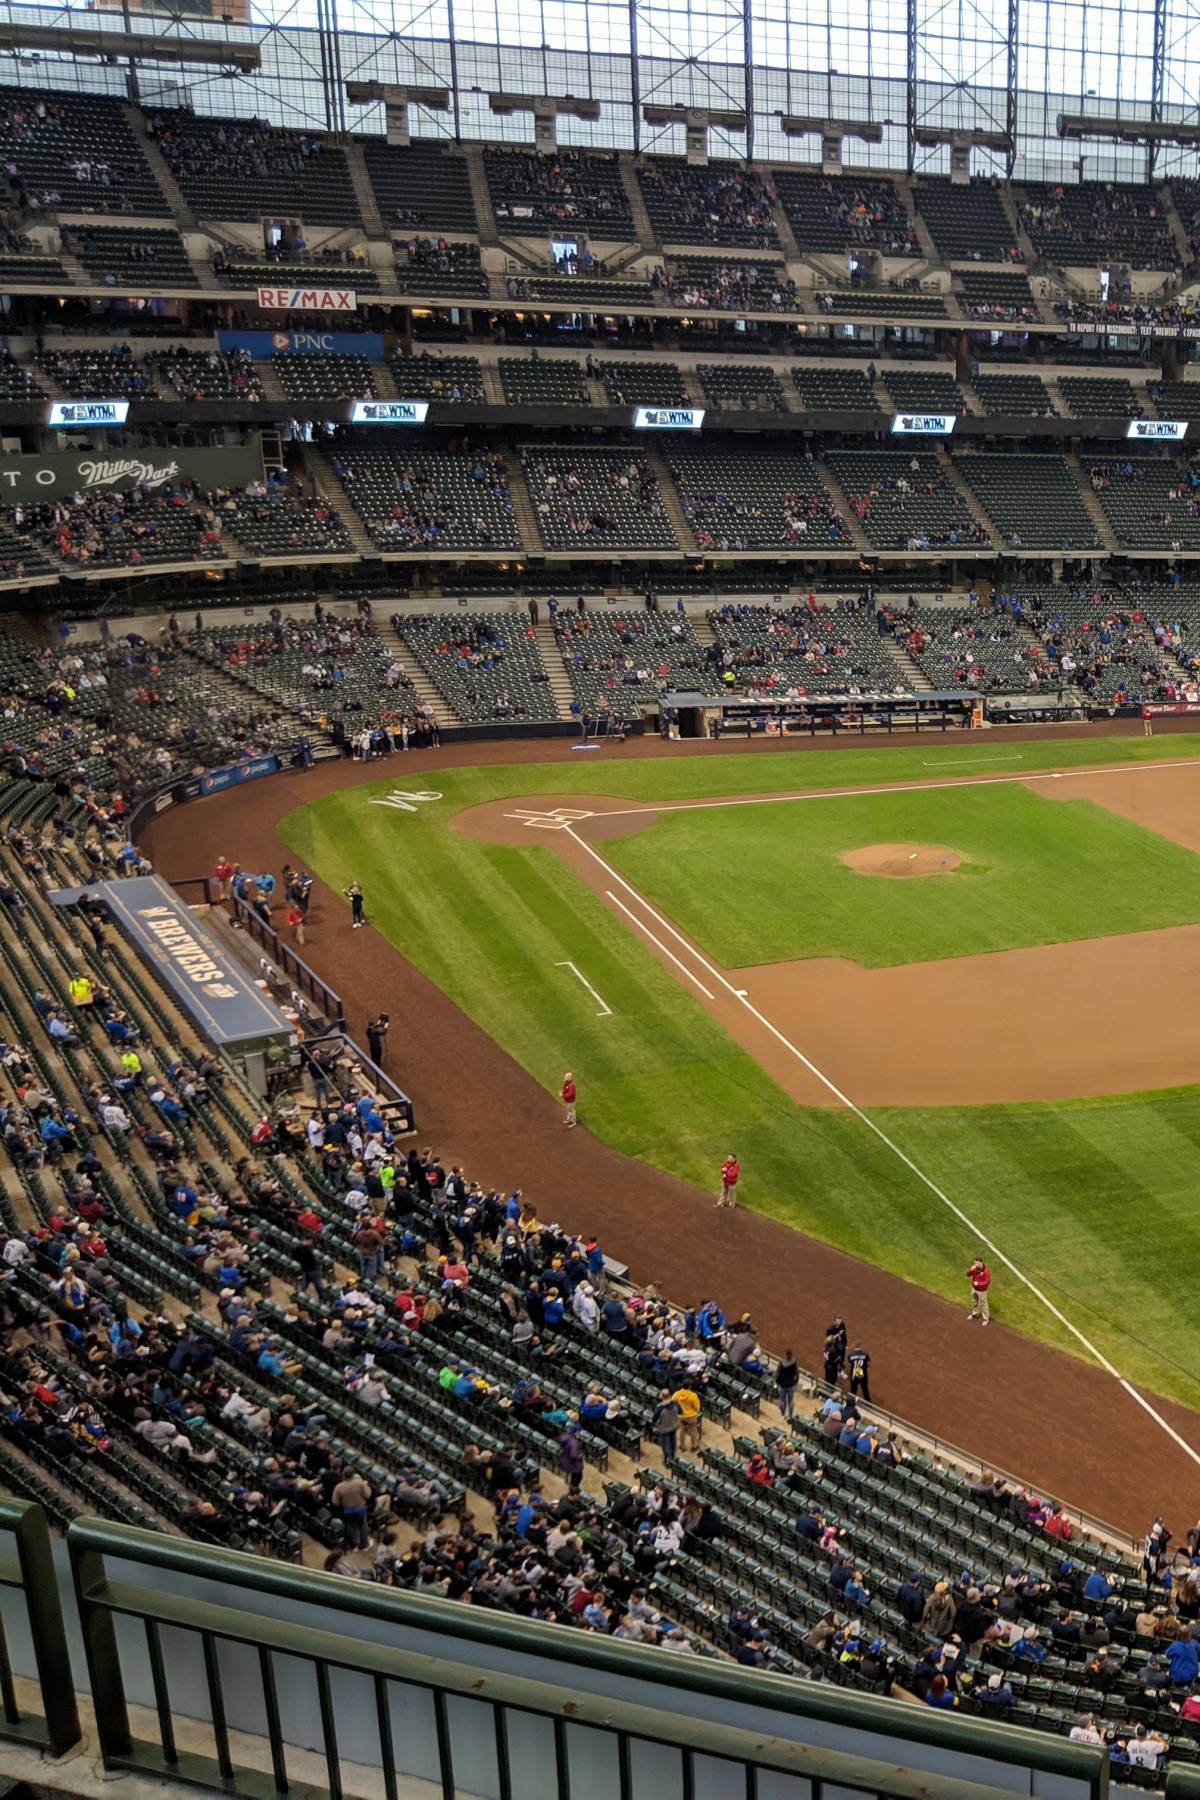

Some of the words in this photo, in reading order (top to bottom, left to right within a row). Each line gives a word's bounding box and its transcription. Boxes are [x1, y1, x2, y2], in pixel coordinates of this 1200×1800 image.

[259, 289, 351, 309] RE/MAX
[1140, 326, 1152, 336] TEXT
[293, 334, 335, 350] PNC
[3, 470, 56, 487] TO
[78, 459, 140, 488] Miller
[129, 461, 182, 489] Park
[146, 918, 225, 982] BREWERS
